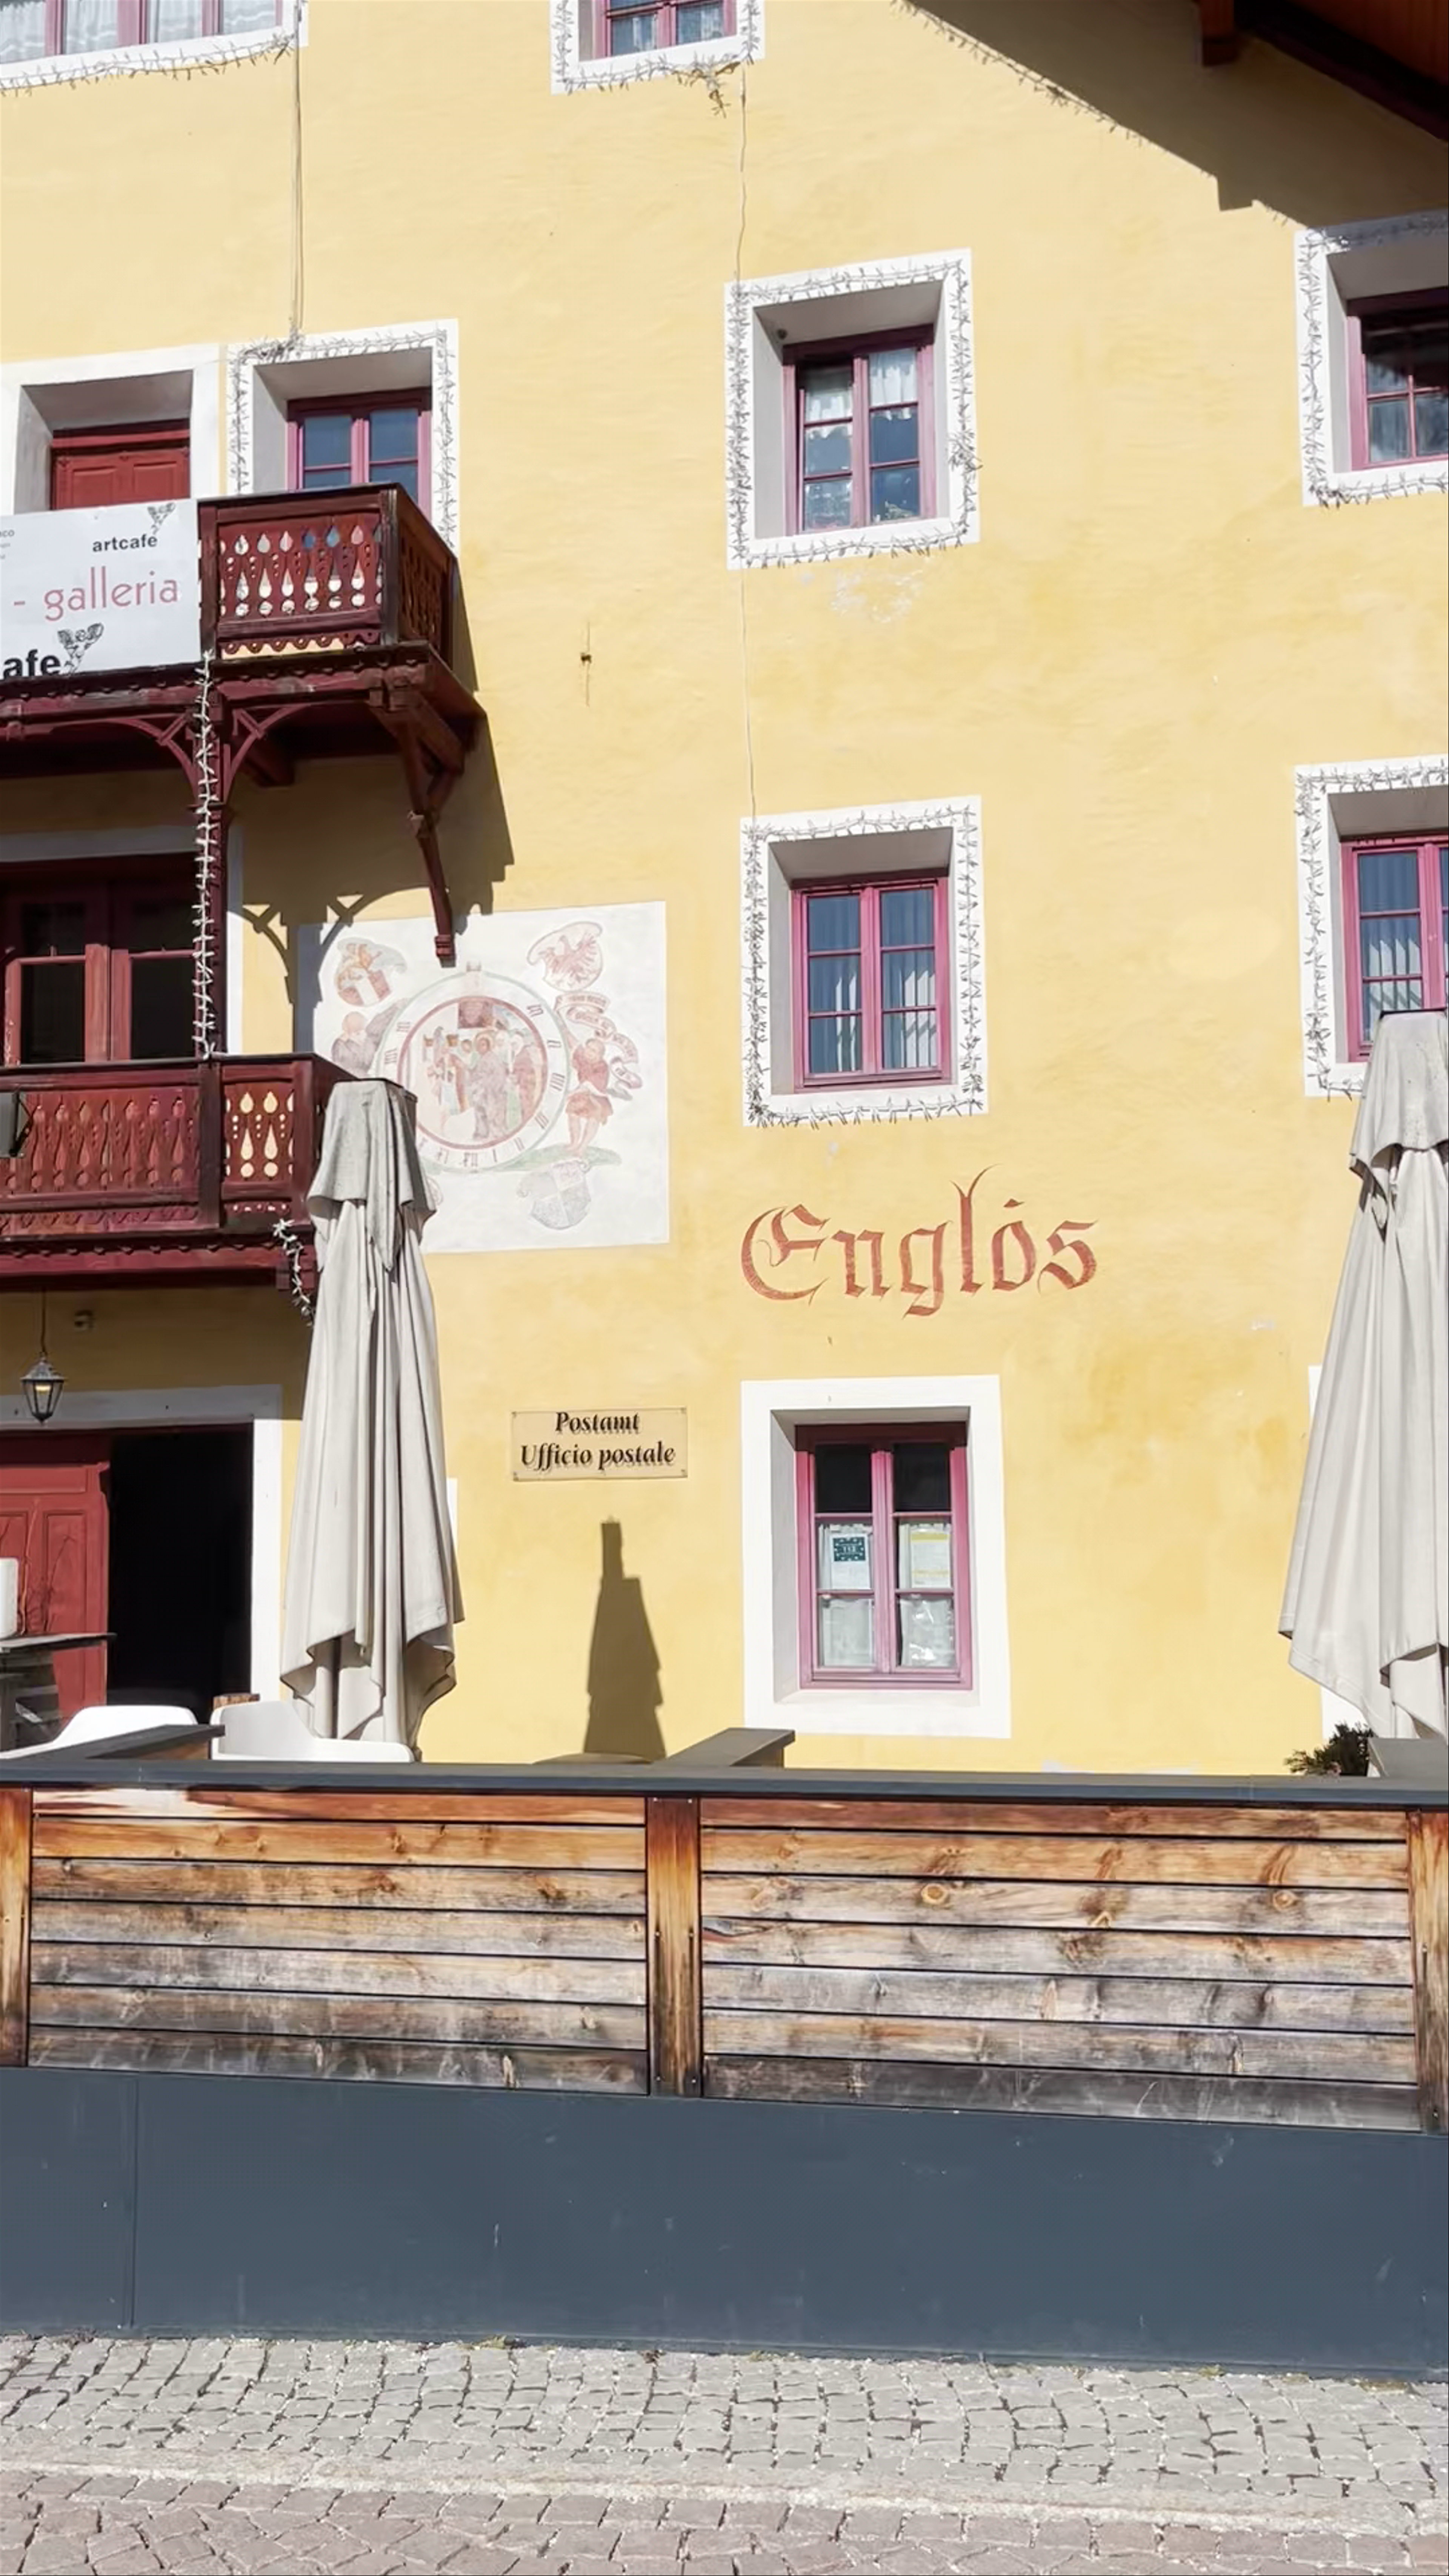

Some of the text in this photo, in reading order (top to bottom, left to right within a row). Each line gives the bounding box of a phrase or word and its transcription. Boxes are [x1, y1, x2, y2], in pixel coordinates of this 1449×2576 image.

[92, 534, 158, 552] artcafe
[44, 566, 178, 621] galleria
[555, 1412, 640, 1432] Postamt
[521, 1441, 675, 1471] Ufficio postale
